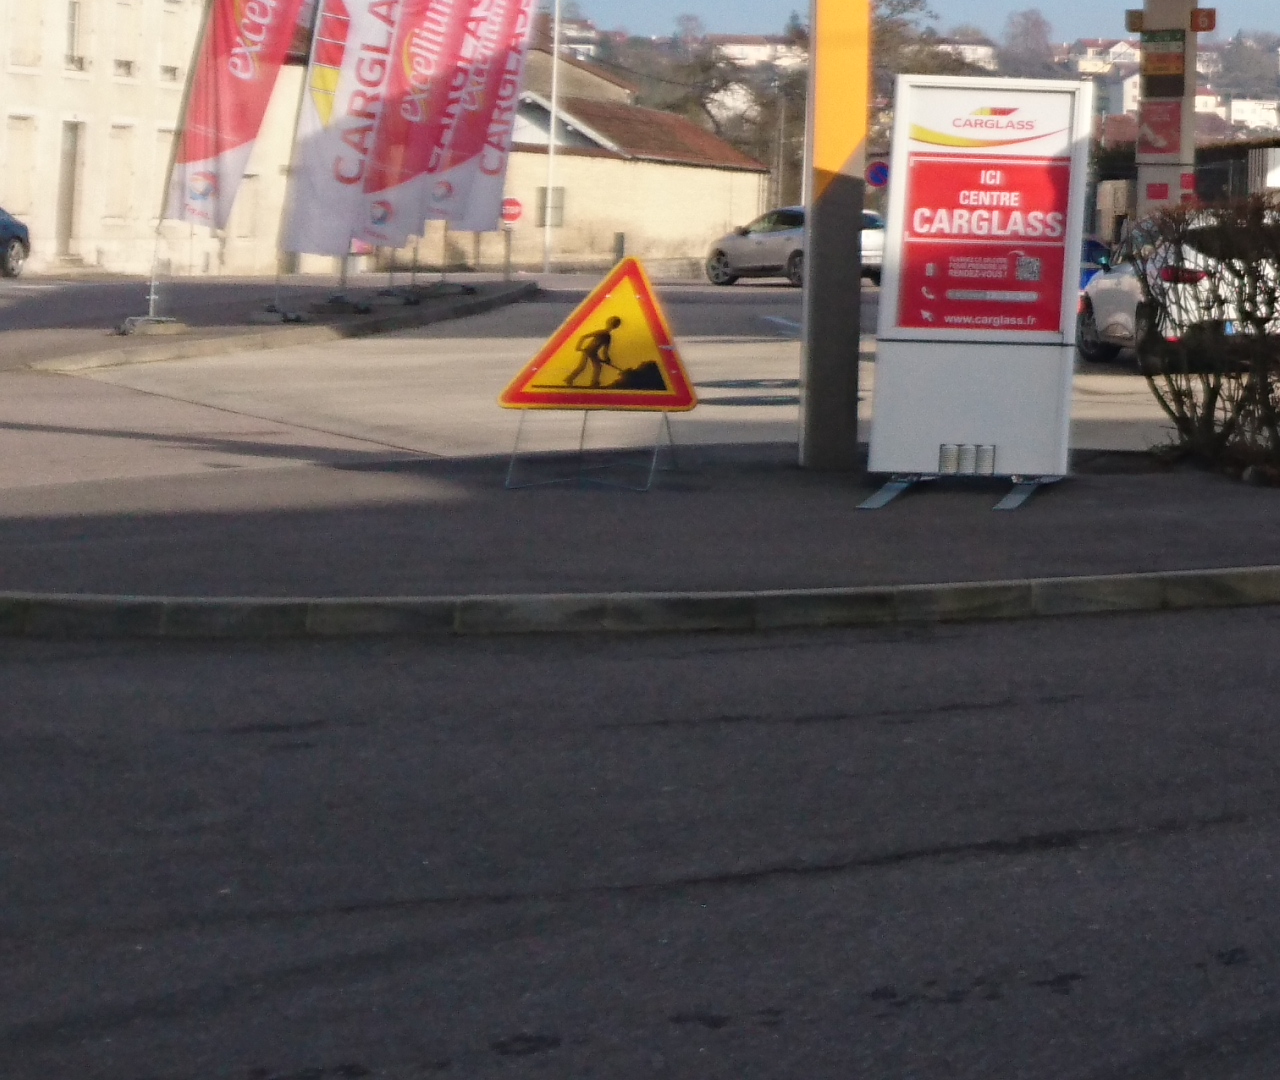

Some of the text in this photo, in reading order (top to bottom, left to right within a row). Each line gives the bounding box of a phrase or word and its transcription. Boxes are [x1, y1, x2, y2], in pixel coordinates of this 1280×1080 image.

[952, 117, 1035, 130] CARGLASS
[980, 169, 1002, 185] ICI
[958, 189, 1020, 207] CENTRE
[912, 207, 1063, 238] CARGLASS
[943, 315, 1037, 327] www.carglass.fr
